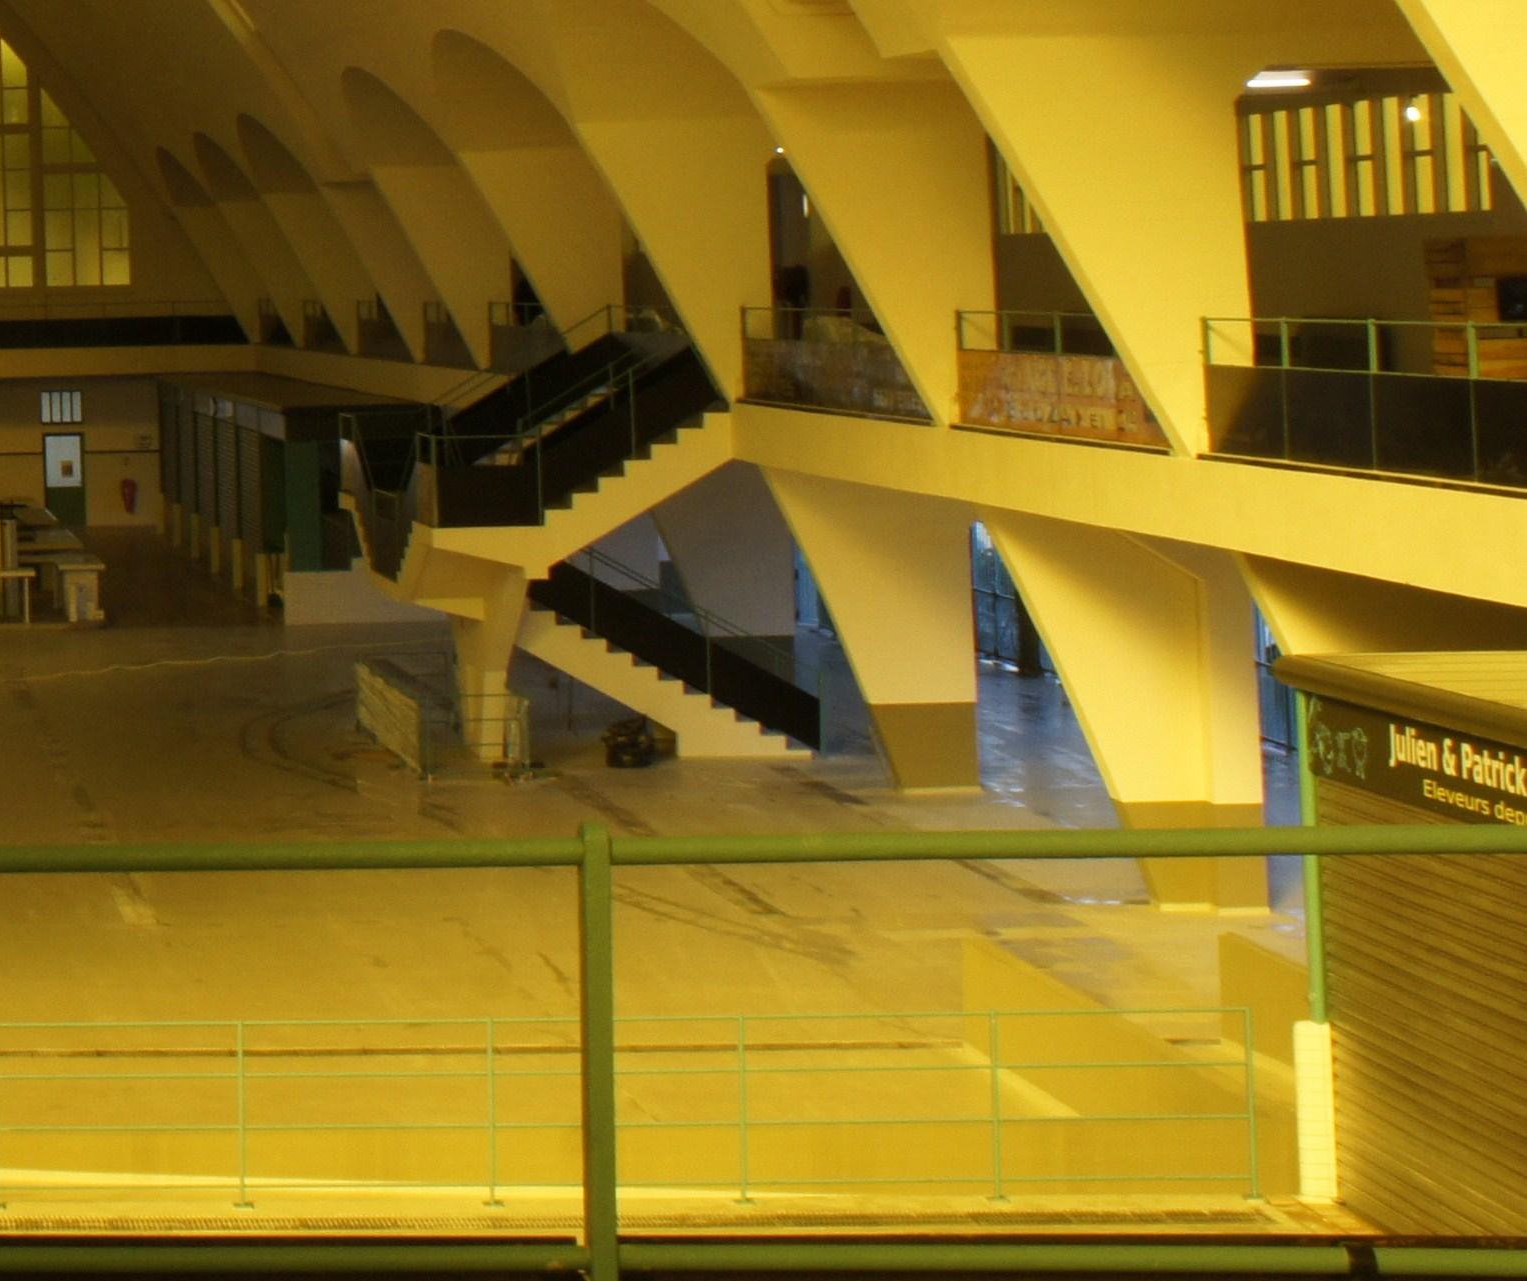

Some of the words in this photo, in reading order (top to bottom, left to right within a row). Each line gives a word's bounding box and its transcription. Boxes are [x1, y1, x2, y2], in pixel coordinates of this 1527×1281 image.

[1388, 723, 1438, 771] Julien
[1442, 737, 1458, 777] &
[1460, 742, 1527, 798] Patrick
[1423, 779, 1491, 816] Eleveurs
[1494, 800, 1527, 827] dep
